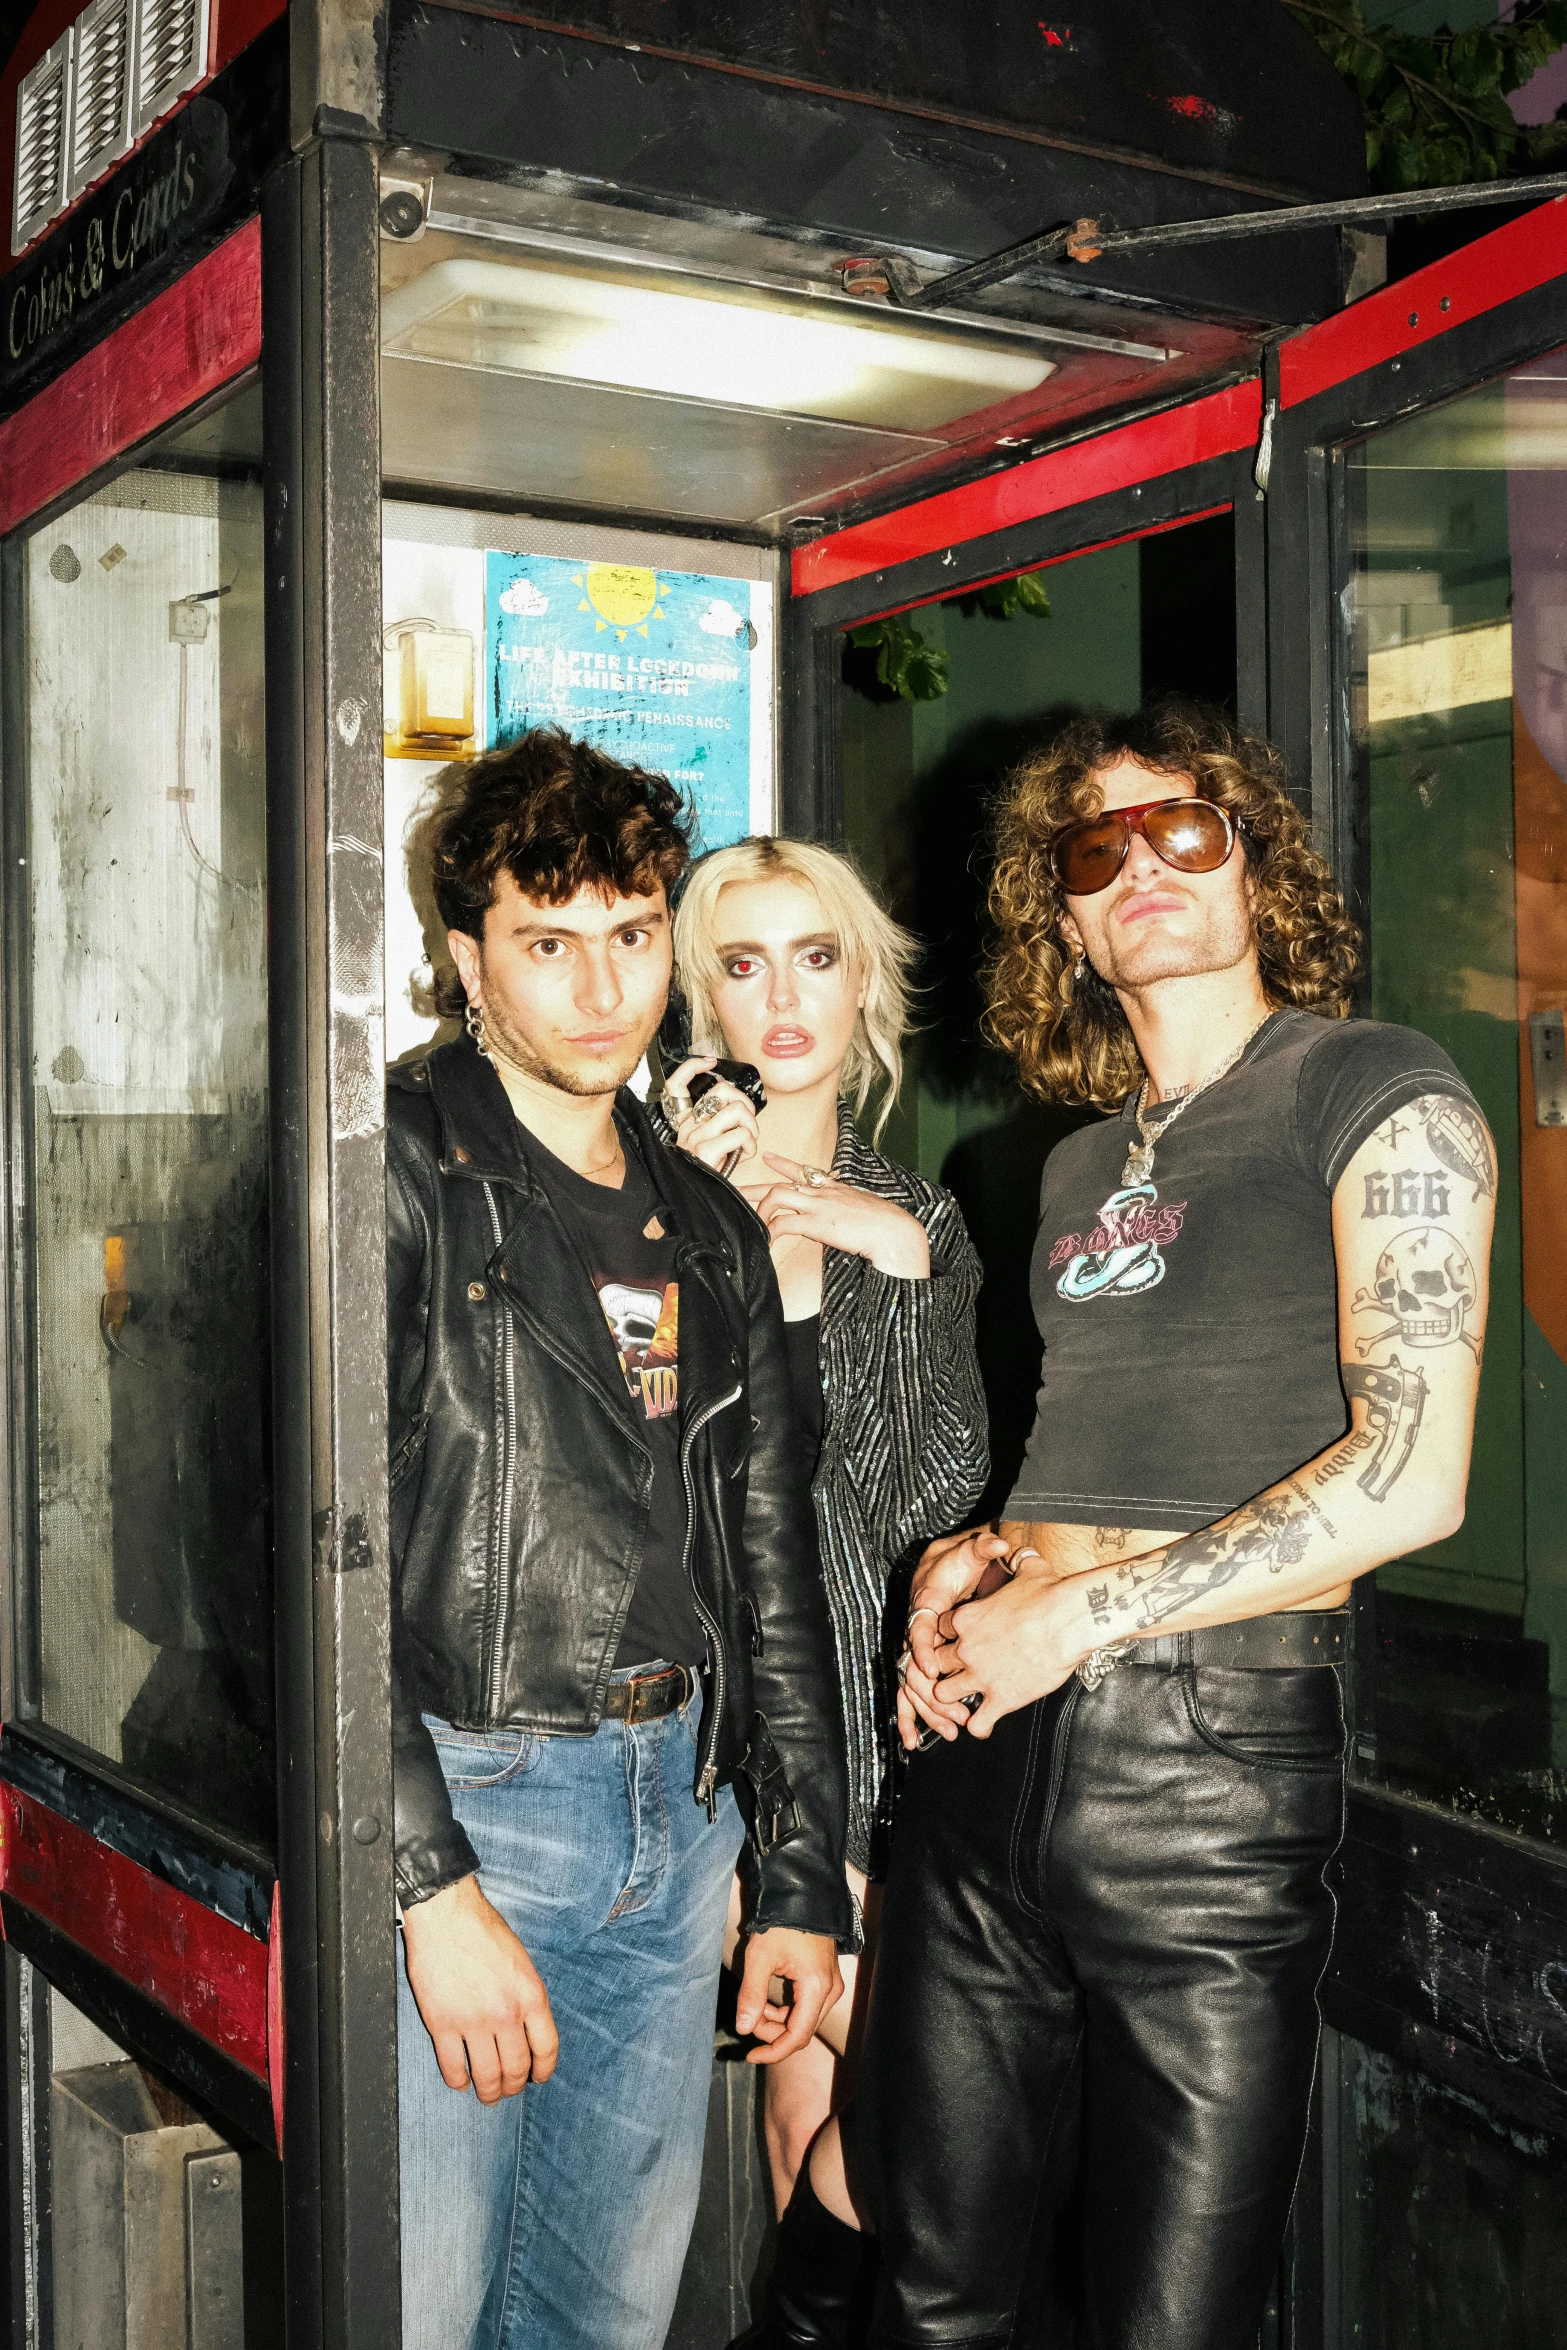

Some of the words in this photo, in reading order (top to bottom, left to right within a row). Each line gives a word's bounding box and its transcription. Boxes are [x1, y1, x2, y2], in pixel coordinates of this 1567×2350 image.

[10, 262, 74, 359] Coins
[80, 217, 104, 299] &
[112, 140, 196, 270] Cards
[499, 644, 546, 662] LIFE
[552, 648, 621, 671] AFTER
[627, 656, 739, 681] LOCKDOWN
[674, 769, 704, 781] FOR?
[1361, 1168, 1451, 1220] 666
[1311, 1430, 1378, 1486] Daddy
[1307, 1499, 1322, 1515] TO
